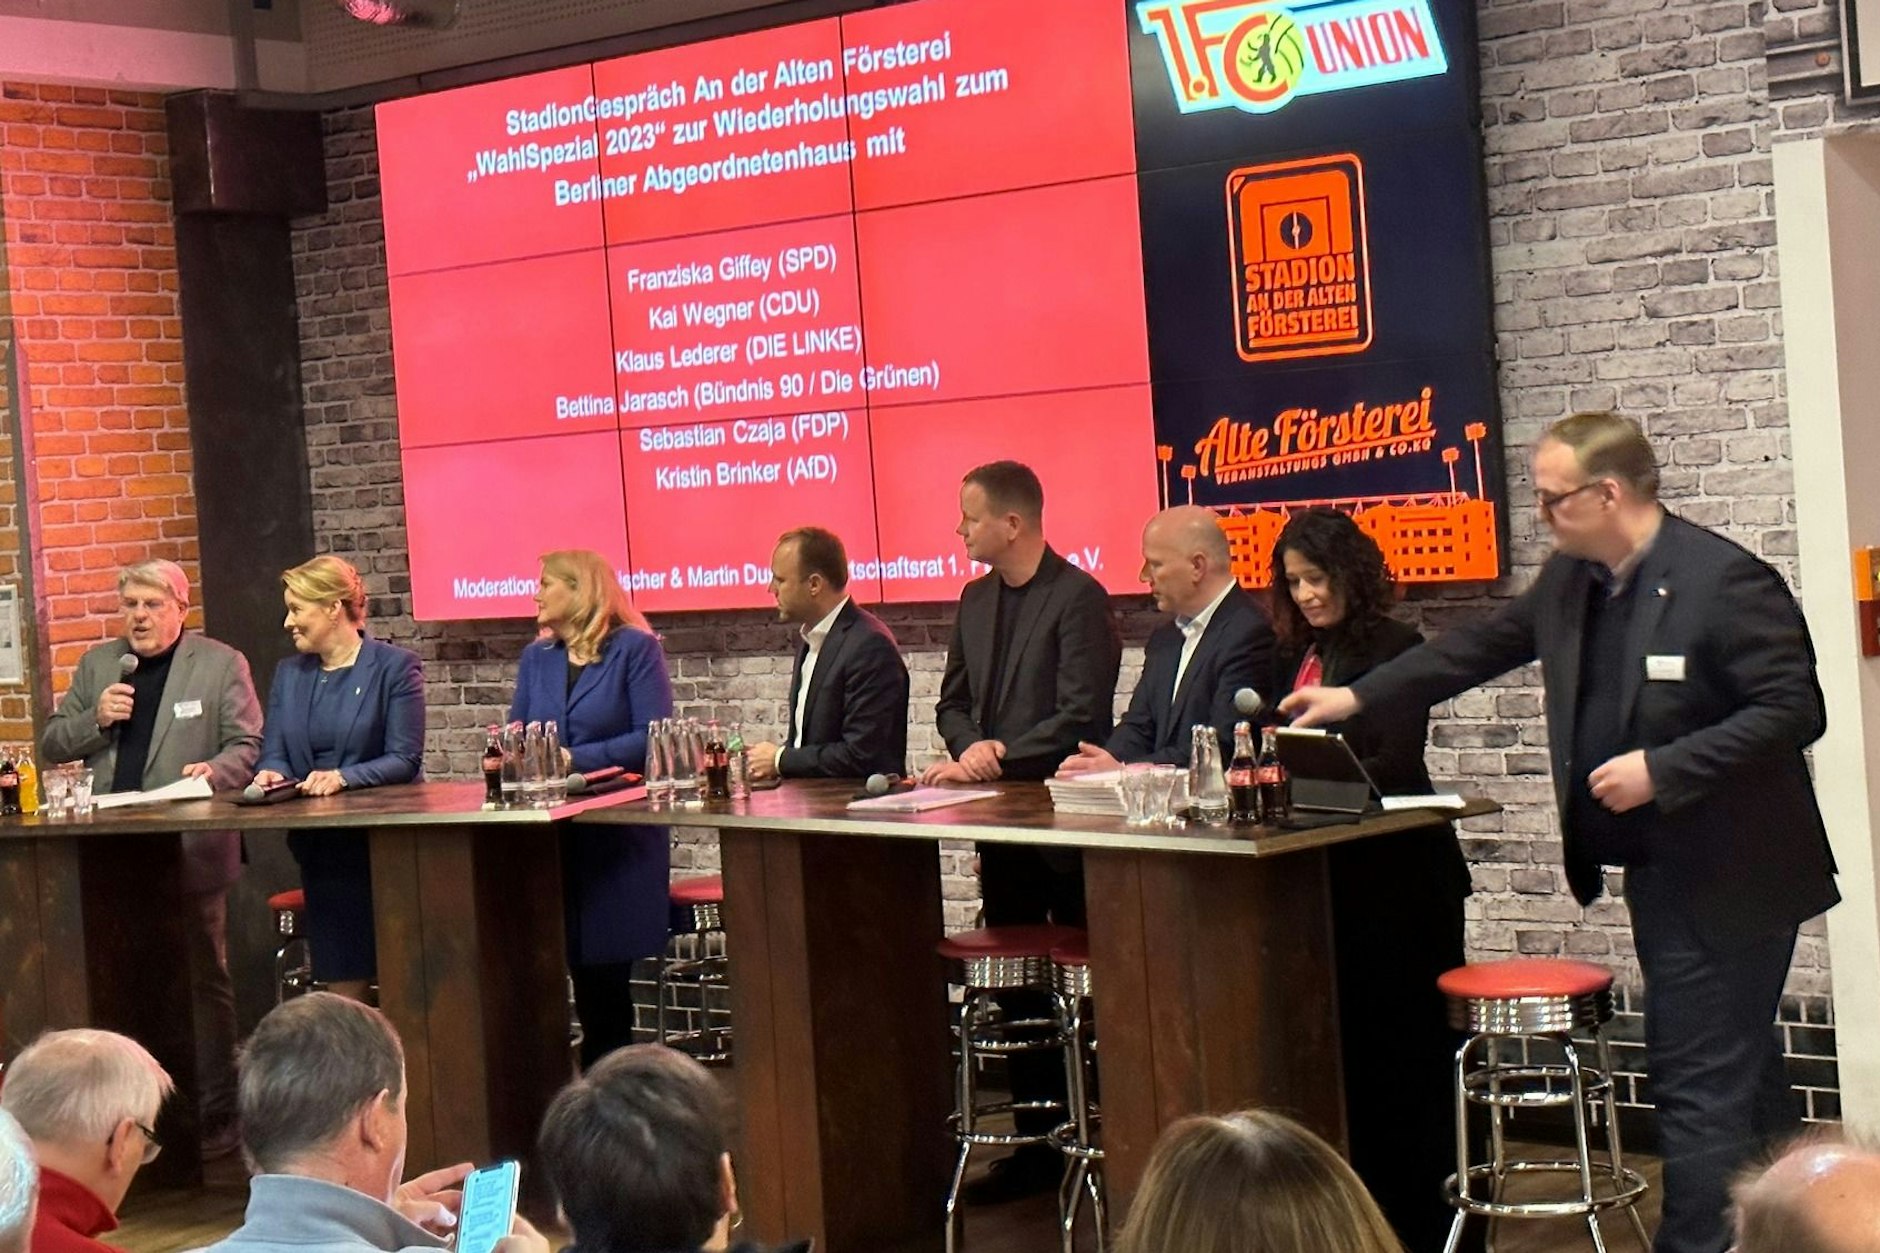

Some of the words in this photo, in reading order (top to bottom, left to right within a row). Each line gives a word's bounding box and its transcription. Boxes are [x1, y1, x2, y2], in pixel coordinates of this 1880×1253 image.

[1305, 7, 1431, 75] UNION
[506, 81, 686, 136] StadionGespräch
[694, 76, 724, 104] An
[731, 69, 767, 98] der
[774, 57, 834, 90] Alten
[843, 30, 951, 77] Försterei
[673, 120, 707, 145] zur
[713, 72, 945, 138] Wiederholungswahl
[956, 68, 1009, 98] zum
[555, 172, 637, 208] Berliner
[643, 141, 856, 194] Abgeordnetenhaus
[867, 126, 906, 159] mit
[628, 261, 713, 293] Franziska
[719, 252, 772, 284] Giffey
[778, 243, 837, 278] (SPD)
[1245, 252, 1356, 292] STADION
[648, 304, 677, 331] Kai
[682, 297, 754, 329] Wegner
[759, 288, 820, 323] (CDU)
[1246, 293, 1269, 313] AN
[1273, 289, 1305, 310] DER
[1307, 282, 1357, 307] ALTEN
[1247, 305, 1358, 339] FÖRSTEREI
[616, 347, 665, 375] Klaus
[670, 341, 738, 369] Lederer
[746, 335, 788, 366] (DIE
[792, 324, 862, 356] LINKE)
[555, 393, 614, 420] Bettina
[620, 385, 689, 415] Jarasch
[694, 376, 774, 411] (Bündnis
[780, 373, 804, 398] 90
[808, 370, 815, 396] /
[820, 367, 852, 395] Die
[861, 360, 940, 391] Grünen)
[639, 423, 726, 452] Sebastian
[732, 417, 786, 447] Czaja
[792, 411, 849, 442] (FDP)
[1195, 417, 1269, 477] Alte
[1273, 387, 1433, 456] Försterei
[656, 462, 712, 491] Kristin
[717, 459, 780, 487] Brinker
[787, 453, 838, 486] (AfD)
[617, 568, 667, 592] ischer
[670, 566, 683, 589] &
[687, 564, 740, 588] Martin
[847, 554, 944, 581] tschaftsrat
[948, 553, 965, 577] 1.
